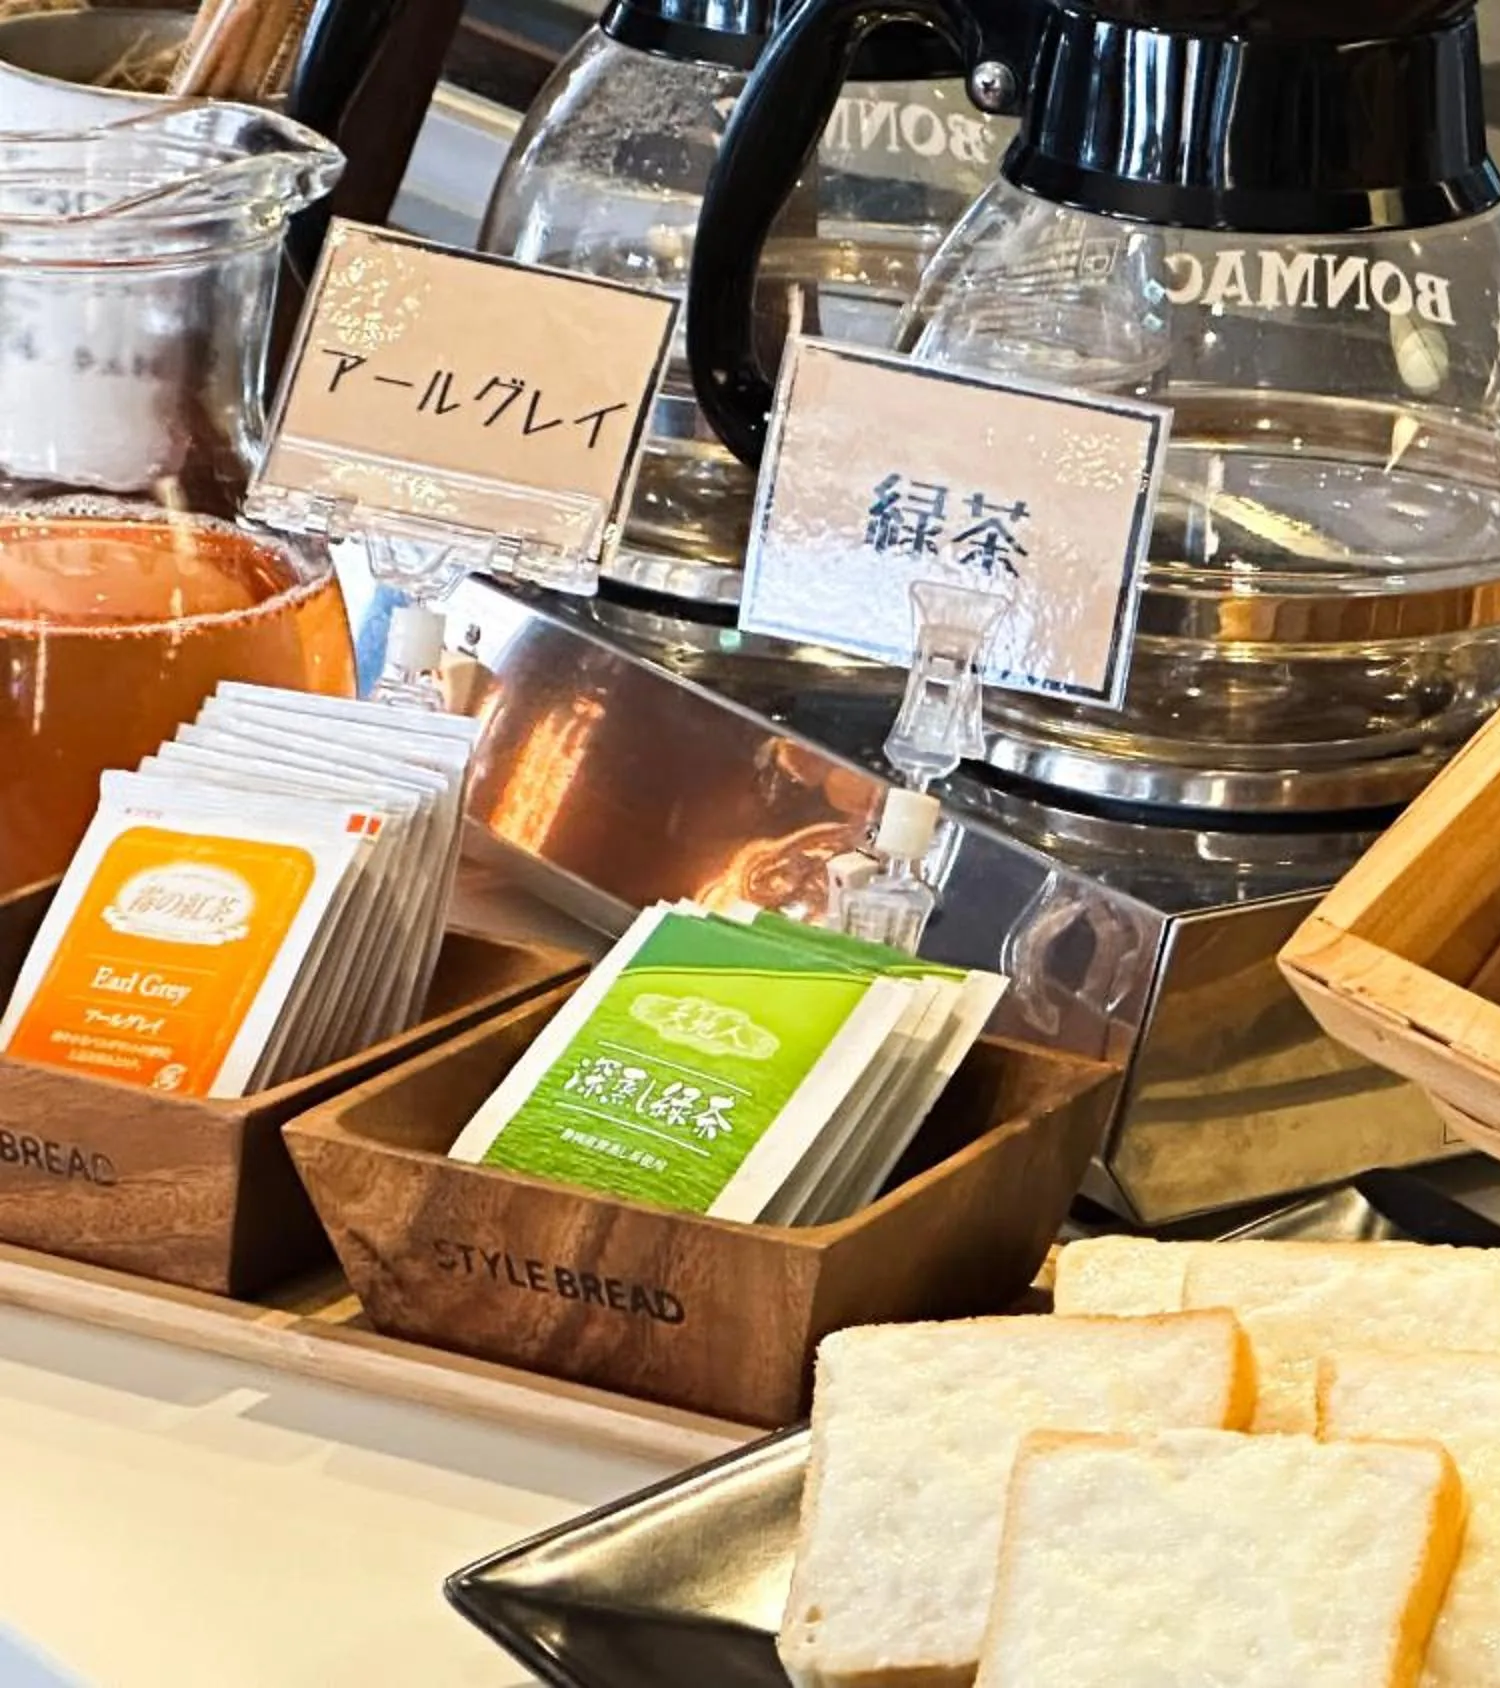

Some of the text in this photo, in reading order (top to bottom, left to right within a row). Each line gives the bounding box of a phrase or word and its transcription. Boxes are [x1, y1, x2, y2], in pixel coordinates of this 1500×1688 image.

[322, 348, 628, 449] アールグレイ
[863, 473, 1030, 578] 緑茶
[91, 966, 192, 1007] Earl Grey
[564, 1058, 736, 1140] 深蒸し緑茶
[0, 1129, 117, 1187] BREAD
[433, 1238, 686, 1327] STYLE BREAD
